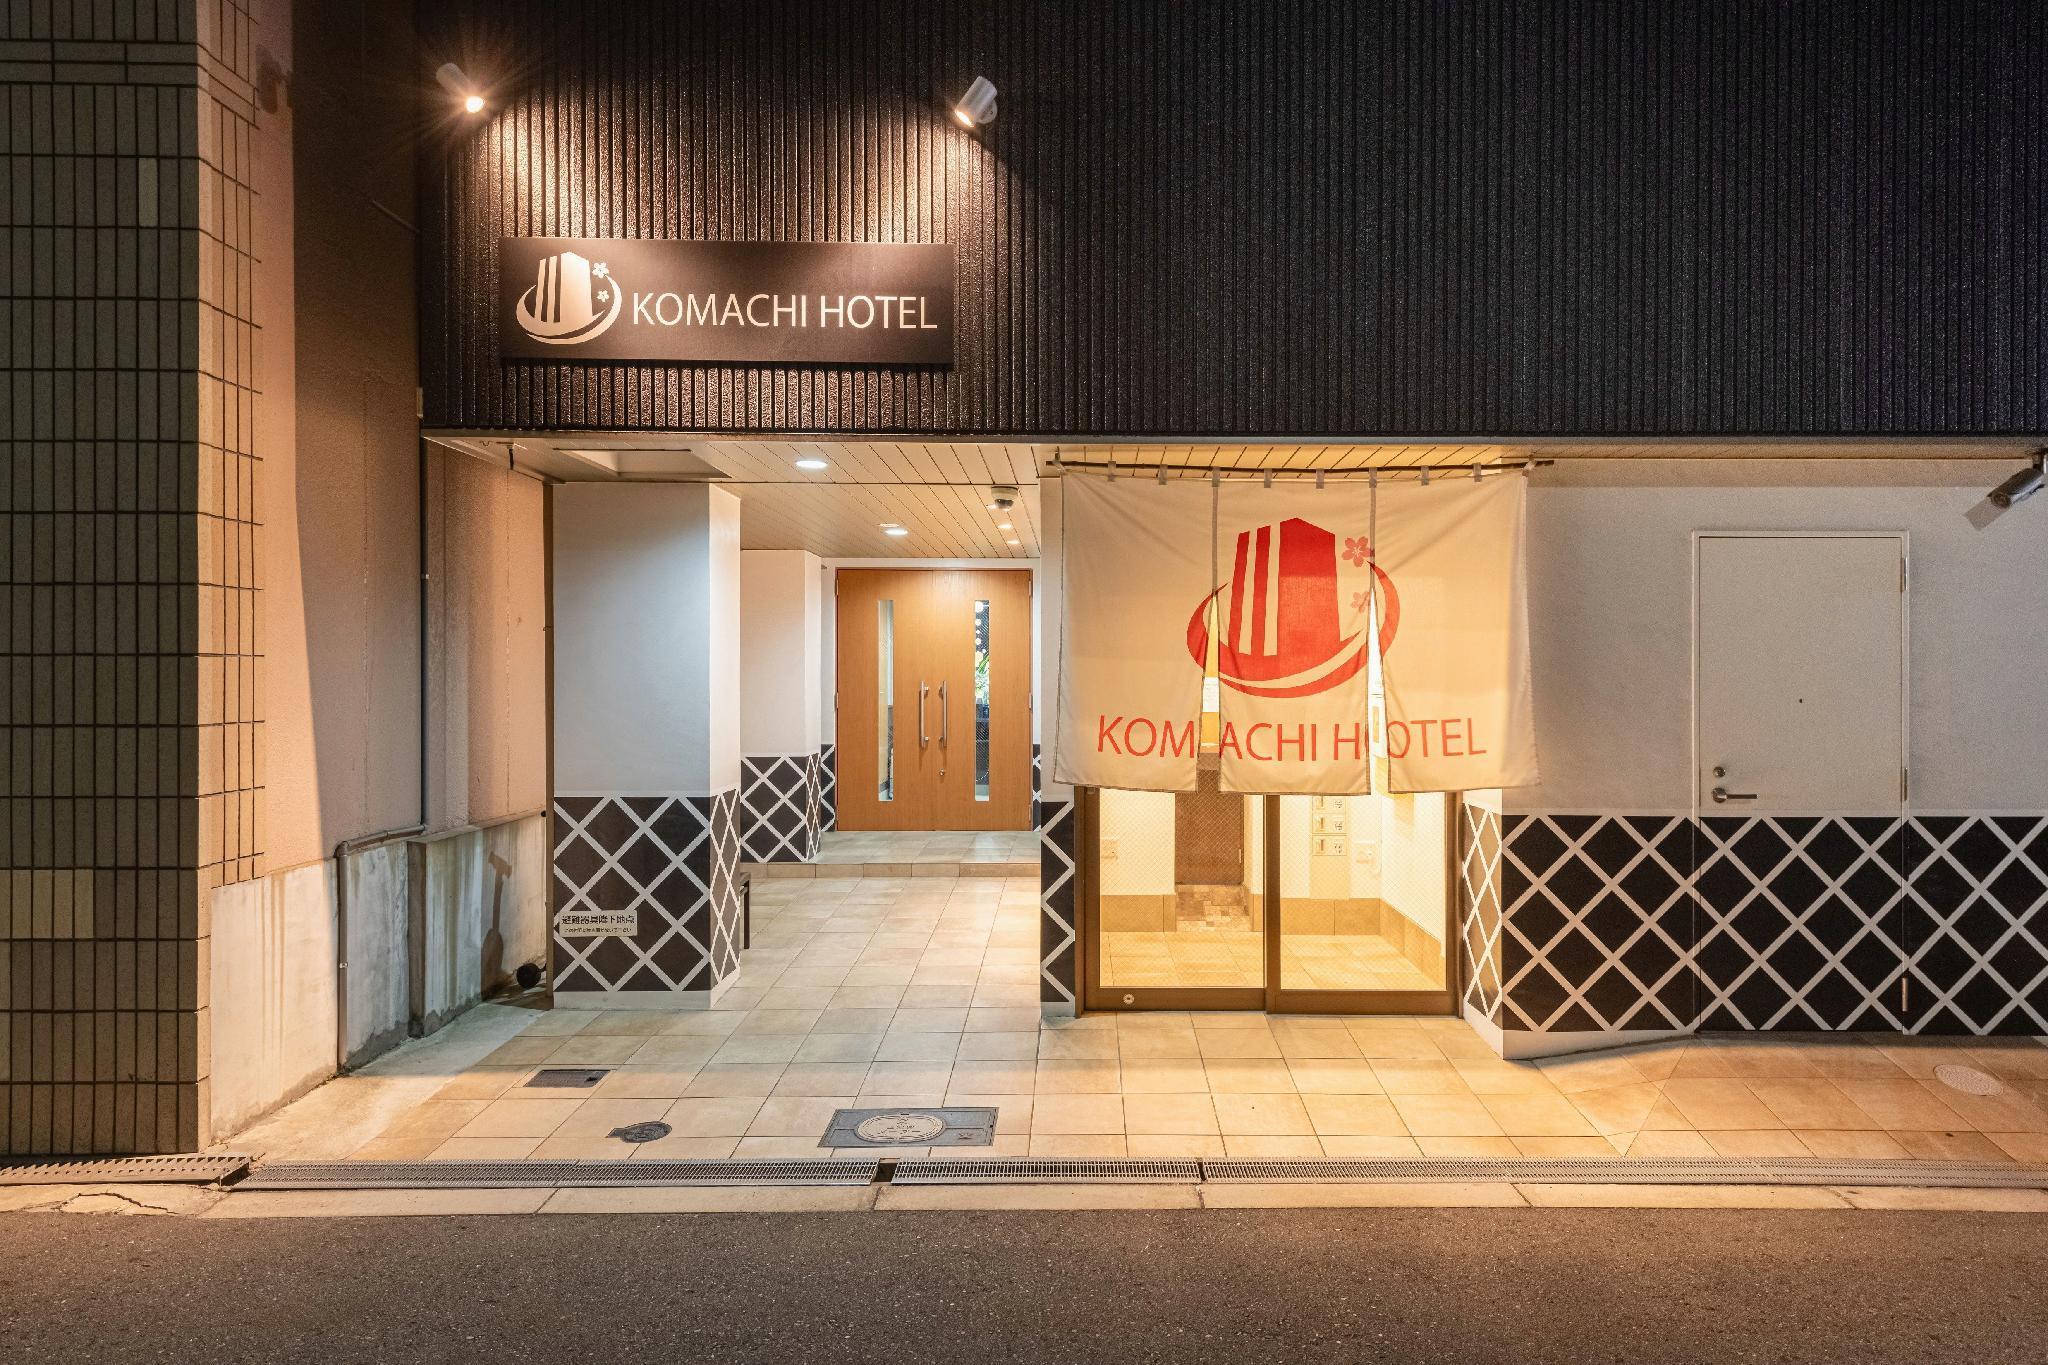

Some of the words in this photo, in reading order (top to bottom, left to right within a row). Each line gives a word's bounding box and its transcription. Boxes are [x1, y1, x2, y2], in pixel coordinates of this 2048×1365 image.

[632, 292, 808, 328] KOMACHI
[820, 295, 938, 330] HOTEL
[1097, 714, 1318, 762] KOMACHI
[1333, 717, 1487, 761] HOTEL
